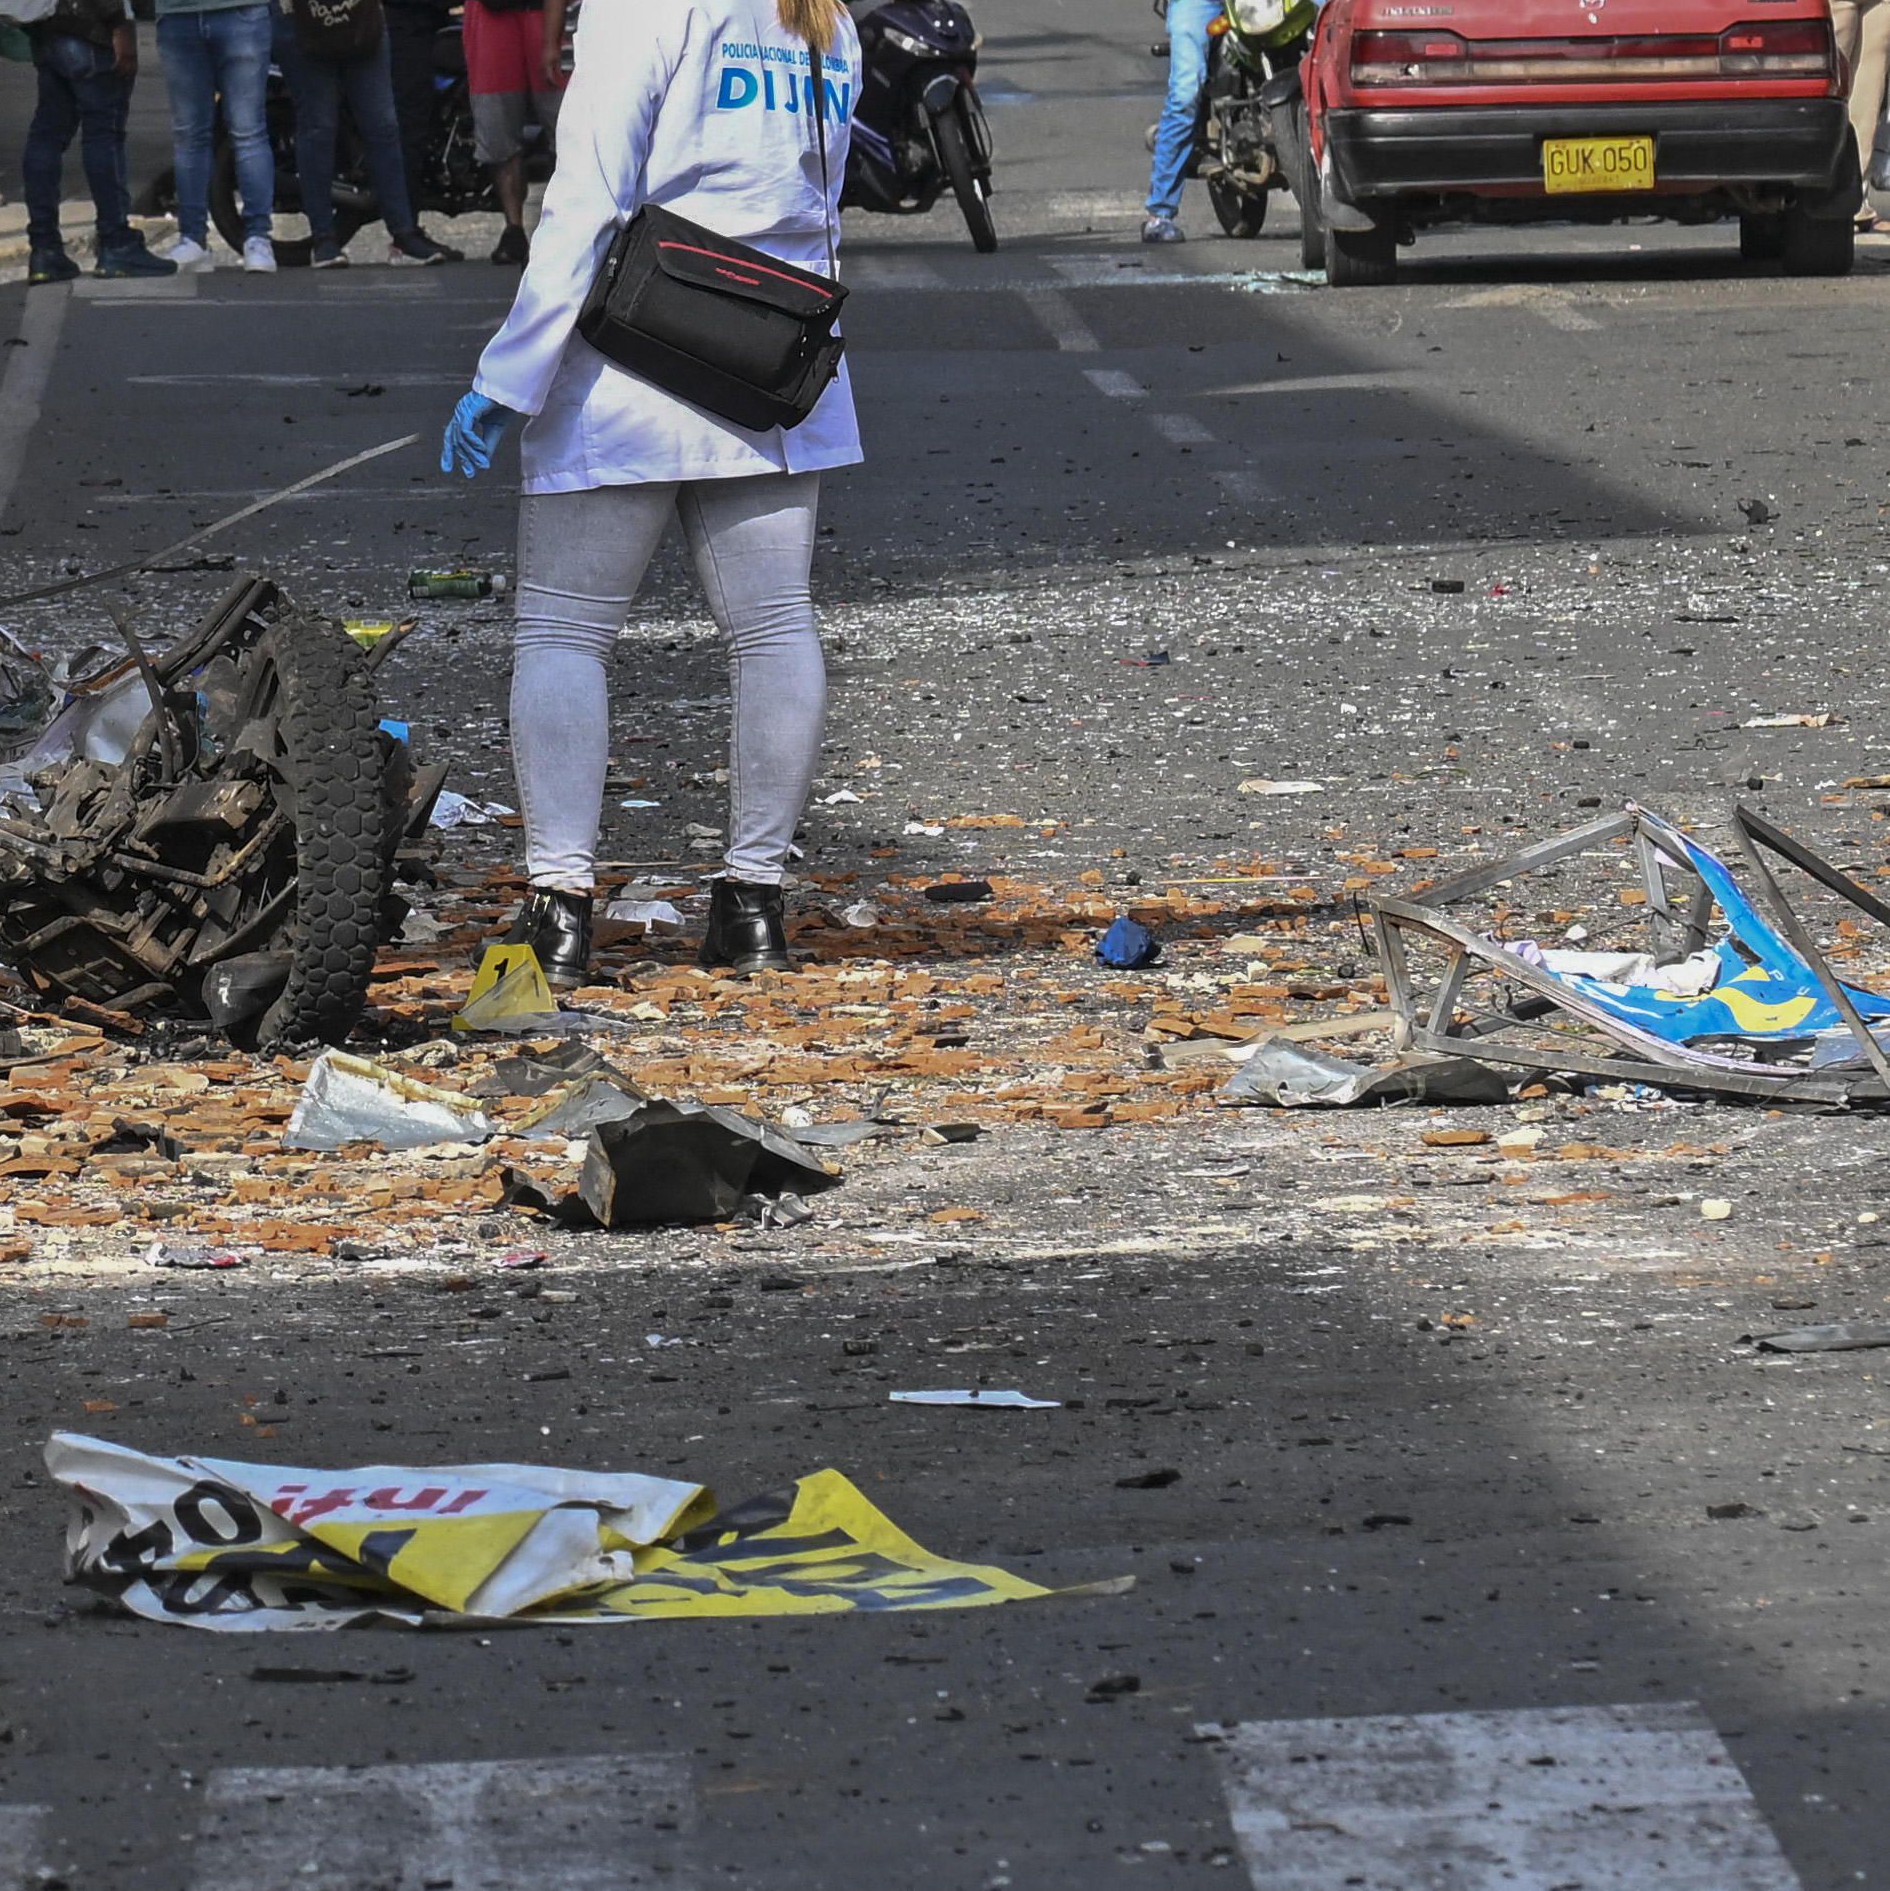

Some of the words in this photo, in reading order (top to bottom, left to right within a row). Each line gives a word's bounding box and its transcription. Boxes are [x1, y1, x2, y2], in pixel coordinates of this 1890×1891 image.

[721, 42, 759, 59] POLICIA
[821, 53, 850, 75] LOMBIA
[716, 66, 850, 125] DIJIN
[1550, 147, 1595, 176] GUK
[1603, 145, 1648, 173] 050
